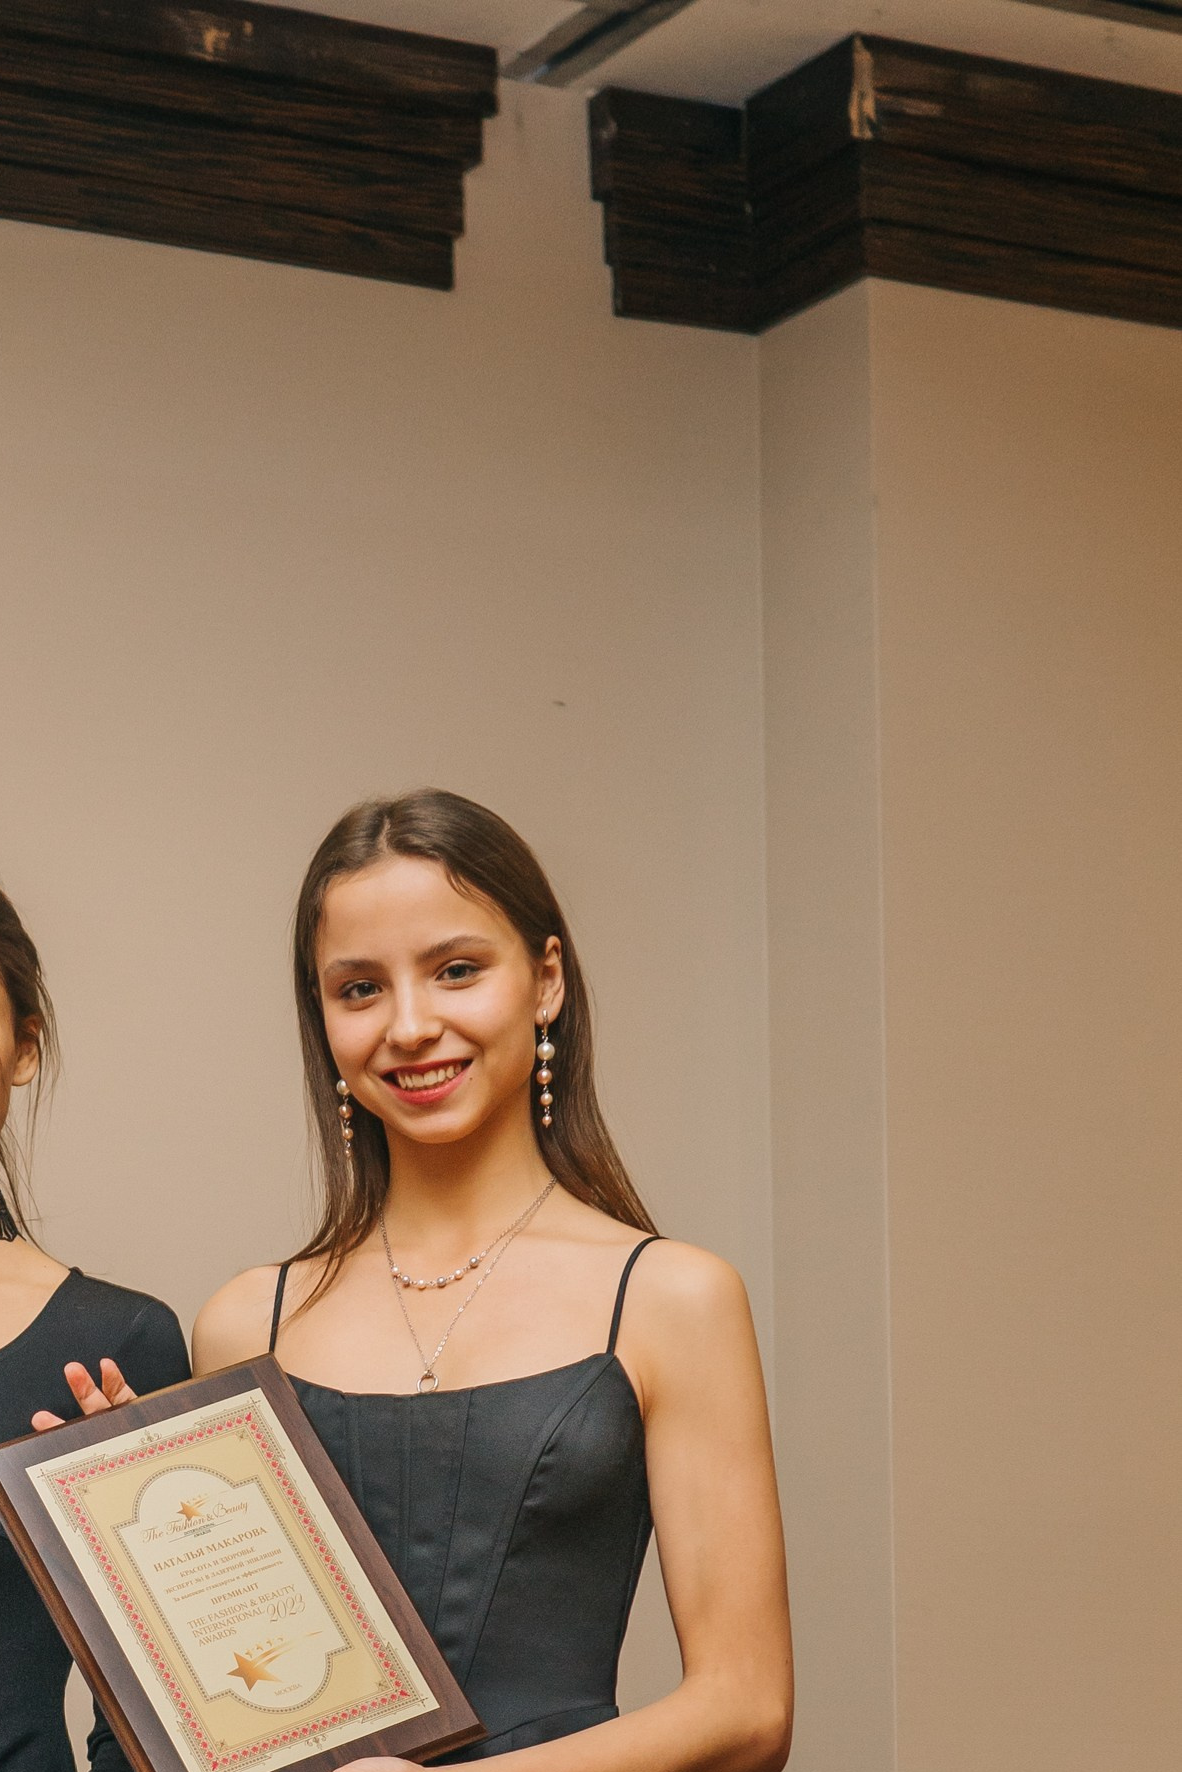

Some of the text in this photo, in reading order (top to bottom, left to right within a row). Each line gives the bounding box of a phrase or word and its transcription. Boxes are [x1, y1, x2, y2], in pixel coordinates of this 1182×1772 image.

[142, 1501, 248, 1543] The Fashion & Beauty
[153, 1527, 268, 1573] НАТАЛЬЯ МАКАРОВА
[179, 1562, 212, 1578] КРАСОТА
[187, 1584, 296, 1630] THE FASHION & BEAUTY
[210, 1582, 259, 1605] ПРЕМИАНТ
[192, 1593, 306, 1638] INTERNATIONAL 2023
[198, 1627, 237, 1647] AWARDS
